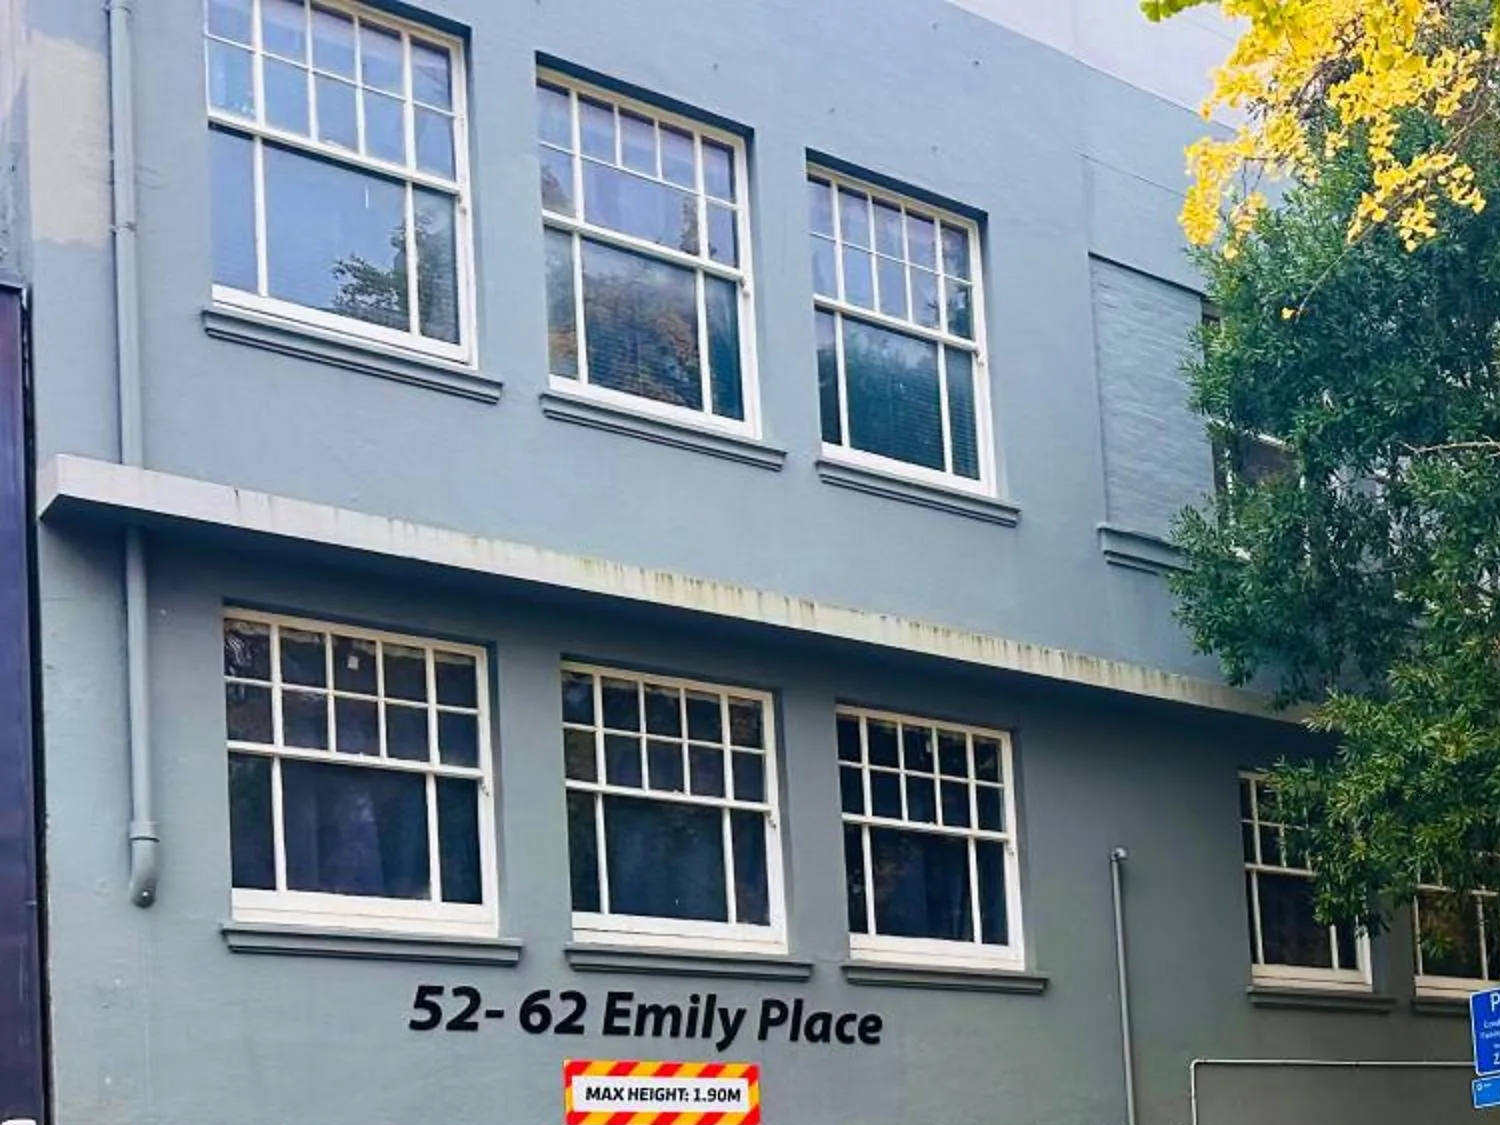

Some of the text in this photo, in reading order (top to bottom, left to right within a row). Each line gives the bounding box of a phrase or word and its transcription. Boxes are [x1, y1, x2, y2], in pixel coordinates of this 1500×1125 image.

[602, 991, 747, 1052] Emily
[757, 998, 884, 1045] Place
[586, 1086, 742, 1103] MAX HEIGHT: 1.90M
